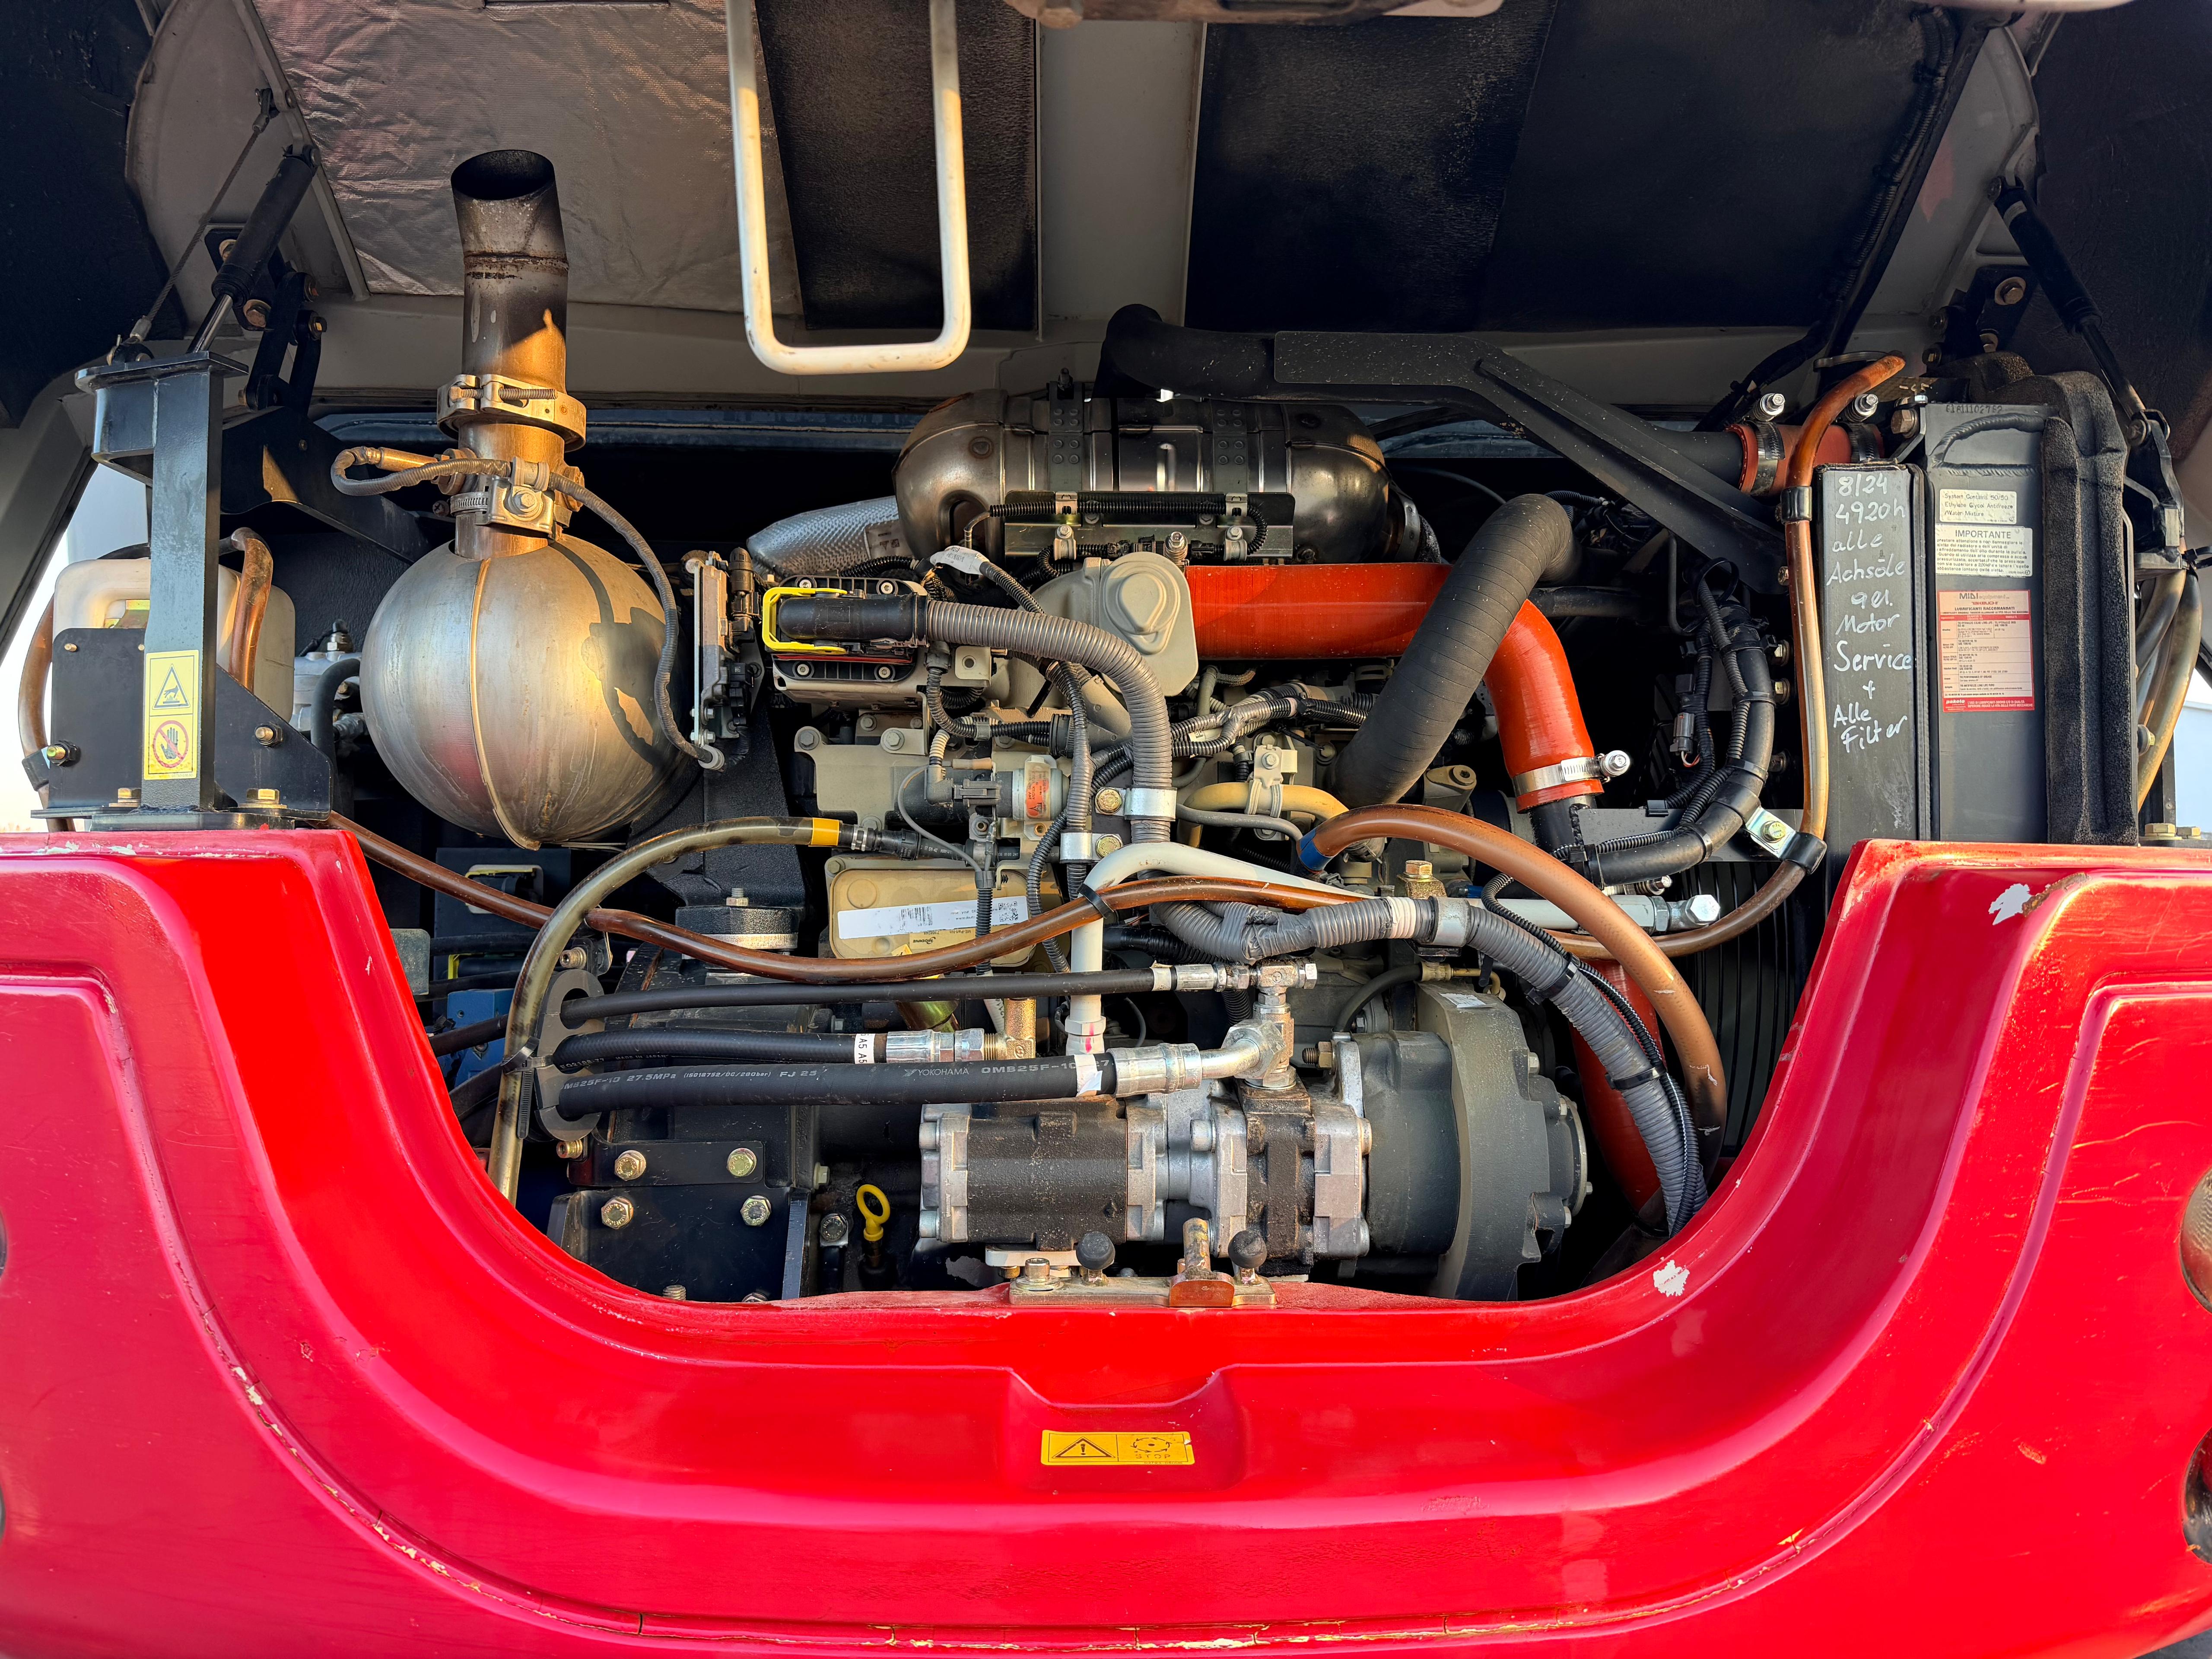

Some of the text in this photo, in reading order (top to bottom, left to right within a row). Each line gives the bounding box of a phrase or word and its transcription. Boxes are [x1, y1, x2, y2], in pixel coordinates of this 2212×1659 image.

[1839, 473, 1888, 496] 8/24
[1832, 529, 1883, 552] alle
[1955, 530, 2011, 539] IMPORTANTE
[1835, 613, 1900, 635] Motor
[1834, 640, 1912, 671] Service
[1833, 702, 1872, 728] Alle
[858, 1039, 867, 1049] A5
[858, 1053, 867, 1063] A5
[626, 1073, 676, 1082] 27.5MPa
[918, 1067, 969, 1076] YOKOHAMA
[981, 1062, 1076, 1074] OMB25F-10
